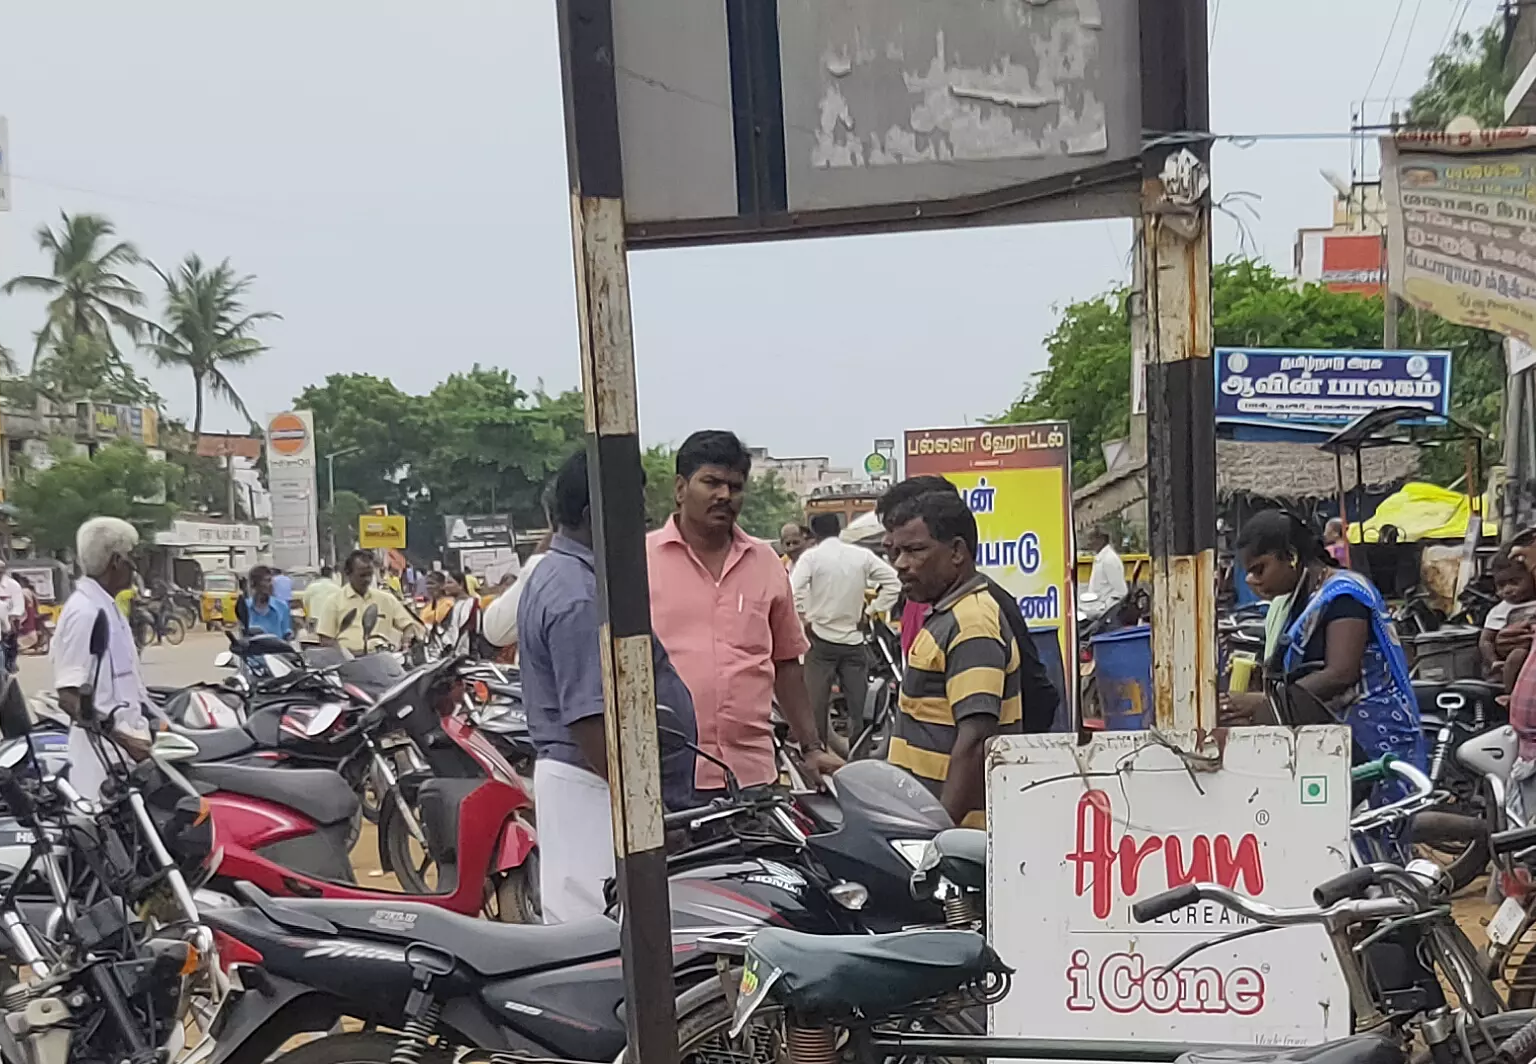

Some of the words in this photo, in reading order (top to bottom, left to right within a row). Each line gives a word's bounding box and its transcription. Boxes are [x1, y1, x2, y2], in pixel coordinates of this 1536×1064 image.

[1221, 371, 1322, 398] ஆவின்
[1327, 372, 1441, 398] பாலகம்
[907, 432, 976, 455] பல்லவா
[980, 426, 1064, 457] ஹோட்டல்
[1066, 789, 1264, 919] Arun
